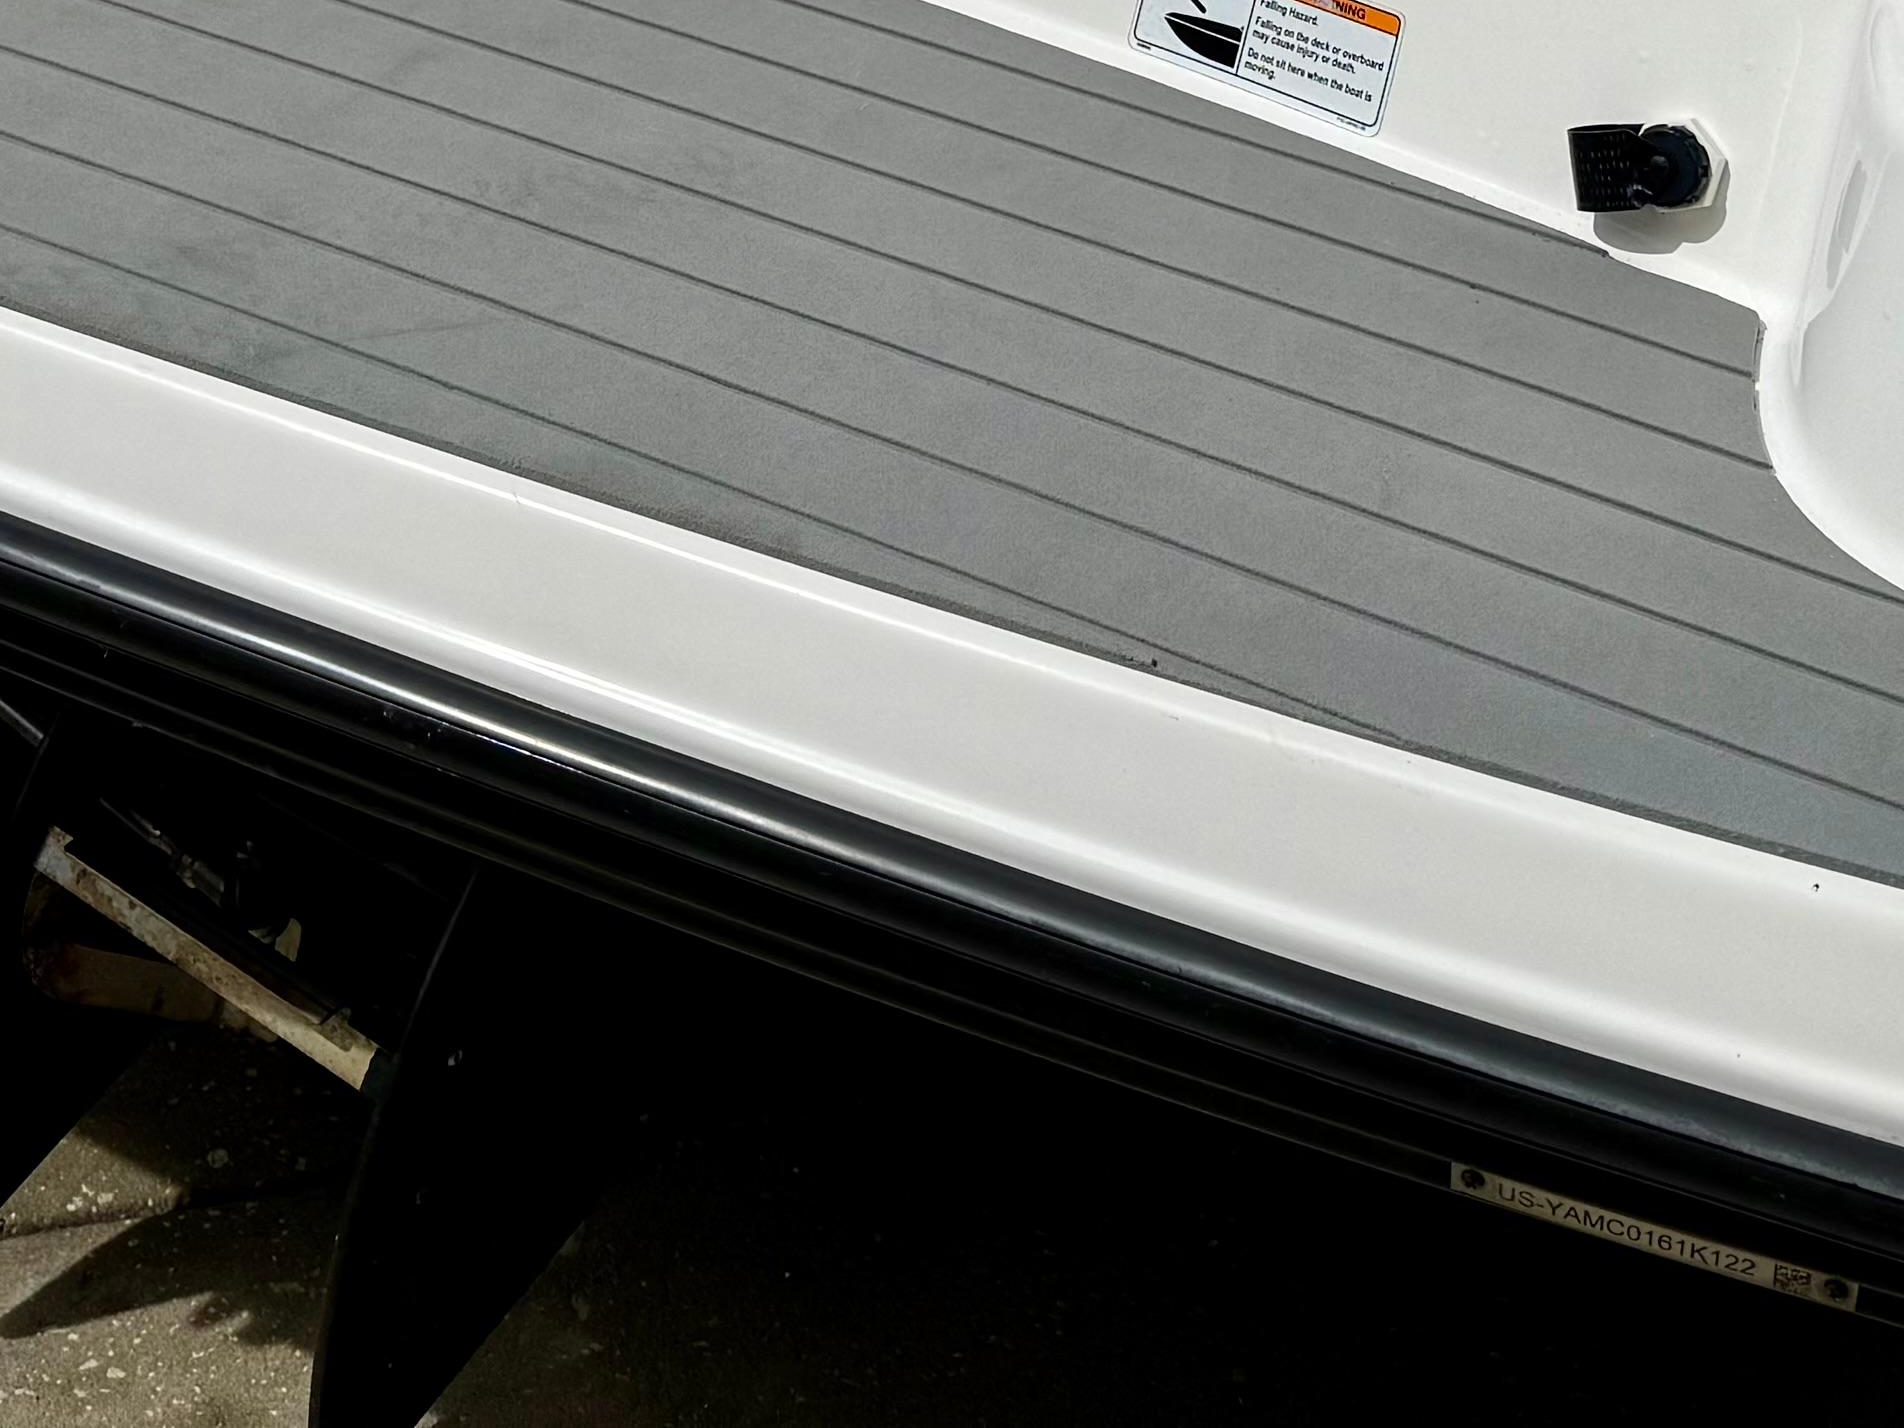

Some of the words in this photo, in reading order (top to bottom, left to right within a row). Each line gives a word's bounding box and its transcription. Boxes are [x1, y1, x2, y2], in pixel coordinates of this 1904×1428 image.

[1288, 7, 1317, 25] Hazard.
[1252, 29, 1268, 43] may
[1270, 36, 1294, 51] cause
[1296, 44, 1319, 62] injury
[1321, 55, 1329, 63] or
[1331, 57, 1355, 73] death.
[1255, 15, 1282, 35] Falling
[1283, 29, 1294, 37] on
[1310, 37, 1329, 51] deck
[1331, 46, 1341, 54] or
[1342, 50, 1384, 71] overboard
[1244, 60, 1275, 80] moving.
[1247, 47, 1258, 59] Do
[1260, 54, 1274, 65] not
[1275, 59, 1286, 70] sit
[1287, 62, 1305, 76] here
[1307, 71, 1328, 85] when
[1344, 83, 1363, 98] boat
[1364, 90, 1371, 102] is
[1496, 1182, 1757, 1277] US-YAMC0161K122
